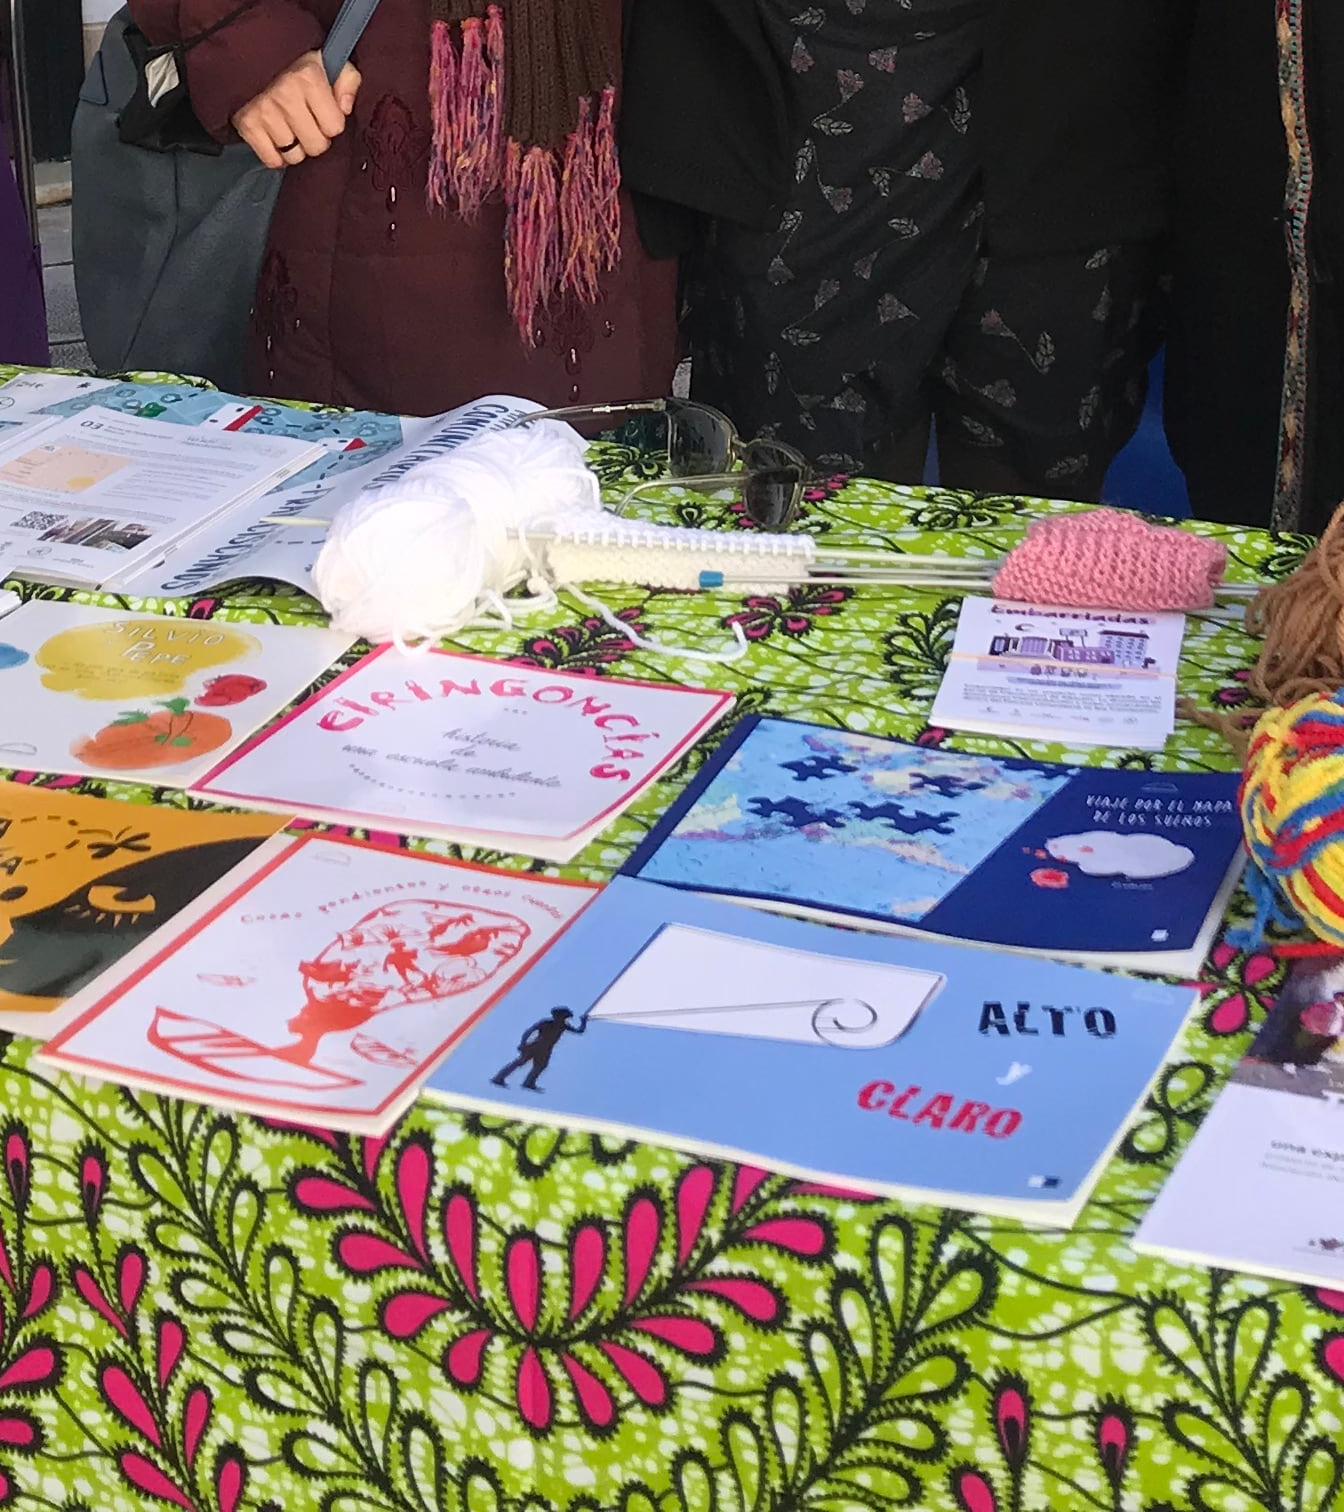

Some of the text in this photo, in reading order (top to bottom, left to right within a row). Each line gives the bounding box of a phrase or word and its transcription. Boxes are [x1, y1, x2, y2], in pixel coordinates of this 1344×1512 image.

[1086, 794, 1130, 811] VIAJE
[977, 999, 1119, 1039] ALTO
[856, 1078, 1025, 1141] CLARO
